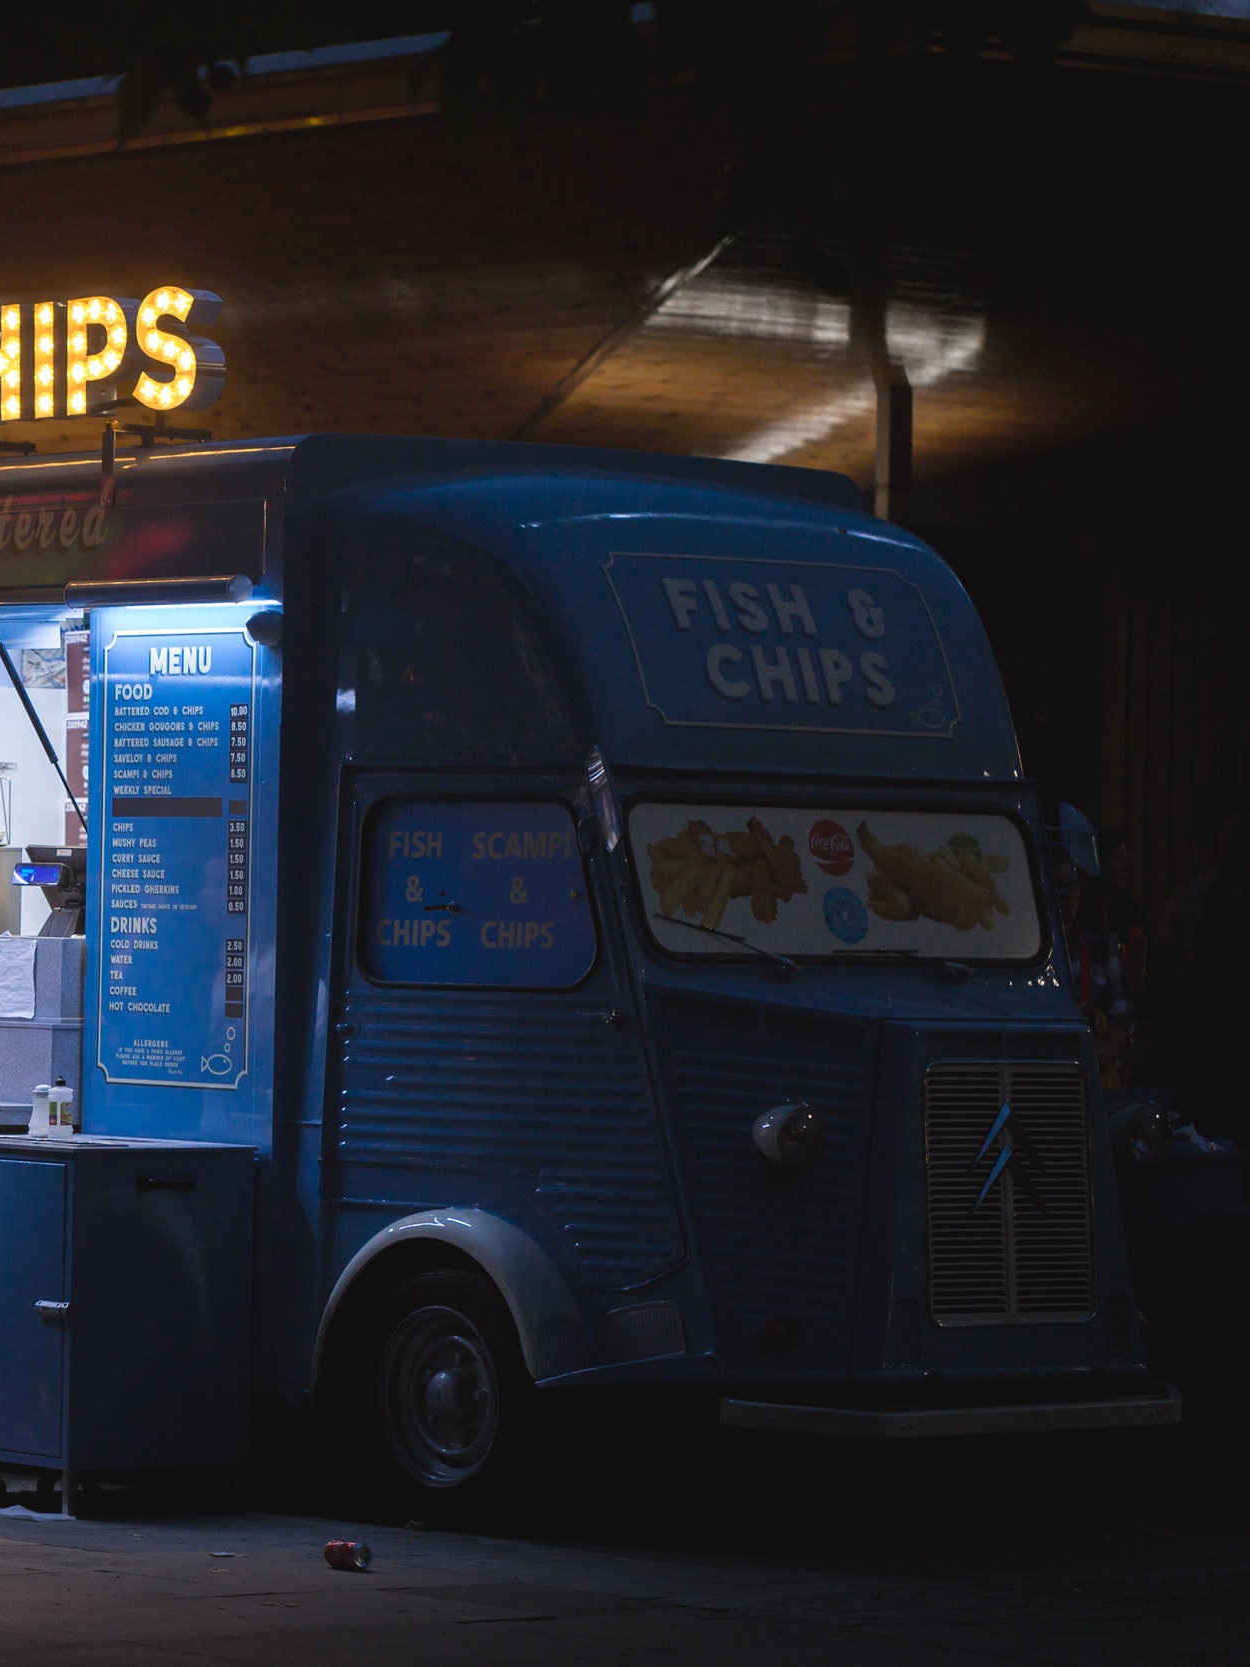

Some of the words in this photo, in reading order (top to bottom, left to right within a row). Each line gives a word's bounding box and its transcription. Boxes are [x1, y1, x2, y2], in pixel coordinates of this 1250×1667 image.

[661, 578, 817, 636] FISH
[847, 589, 886, 640] &
[150, 646, 212, 675] MENU
[706, 643, 896, 708] CHIPS
[114, 684, 153, 700] FOOD
[114, 706, 150, 716] BATTERED
[153, 706, 169, 716] COD
[182, 706, 204, 716] CHIPS
[230, 706, 248, 716] 10.00
[114, 722, 146, 731] CHICKEN
[149, 722, 185, 731] GOUGONS
[198, 722, 220, 731] CHIPS
[231, 722, 247, 731] 8.50
[114, 738, 149, 747] BATTERED
[152, 738, 184, 747] SAUSAGE
[196, 738, 218, 747] CHIPS
[231, 737, 247, 746] 7.50
[114, 754, 144, 763] SAVELOY
[156, 754, 177, 763] CHIPS
[230, 753, 246, 762] 7.50
[114, 770, 139, 778] SCAMPI
[152, 770, 173, 778] CHIPS
[230, 769, 246, 778] 8.50
[114, 786, 140, 795] WEEKLY
[144, 786, 171, 795] SPECIAL
[113, 823, 134, 832] CHIPS
[229, 822, 245, 832] 3.50
[112, 839, 136, 847] MUSHY
[139, 839, 157, 847] PEAS
[230, 839, 244, 848] 1.50
[389, 831, 443, 858] FISH
[472, 832, 573, 860] SCAMPI
[112, 855, 134, 863] CURRY
[138, 855, 160, 863] SAUCE
[230, 855, 244, 863] 1.50
[112, 870, 139, 878] CHEESE
[142, 870, 165, 878] SAUCE
[230, 871, 244, 879] 1.50
[112, 885, 140, 894] PICKLED
[144, 885, 180, 894] GHERKINS
[229, 886, 243, 895] 1.00
[406, 875, 424, 902] &
[510, 876, 527, 904] &
[111, 900, 138, 909] SAUCES
[228, 902, 244, 911] 0.50
[111, 917, 157, 933] DRINKS
[376, 920, 451, 947] CHIPS
[480, 921, 555, 949] CHIPS
[110, 940, 129, 949] COLD
[134, 940, 158, 949] DRINKS
[227, 941, 242, 950] 2.50
[110, 955, 132, 964] WATER
[227, 957, 242, 966] 2.00
[110, 971, 123, 980] TEA
[226, 974, 242, 983] 2.00
[110, 986, 137, 996] COFFEE
[109, 1002, 123, 1011] HOT
[128, 1002, 170, 1013] CHOCOLATE
[133, 1039, 168, 1047] ALLERGENS
